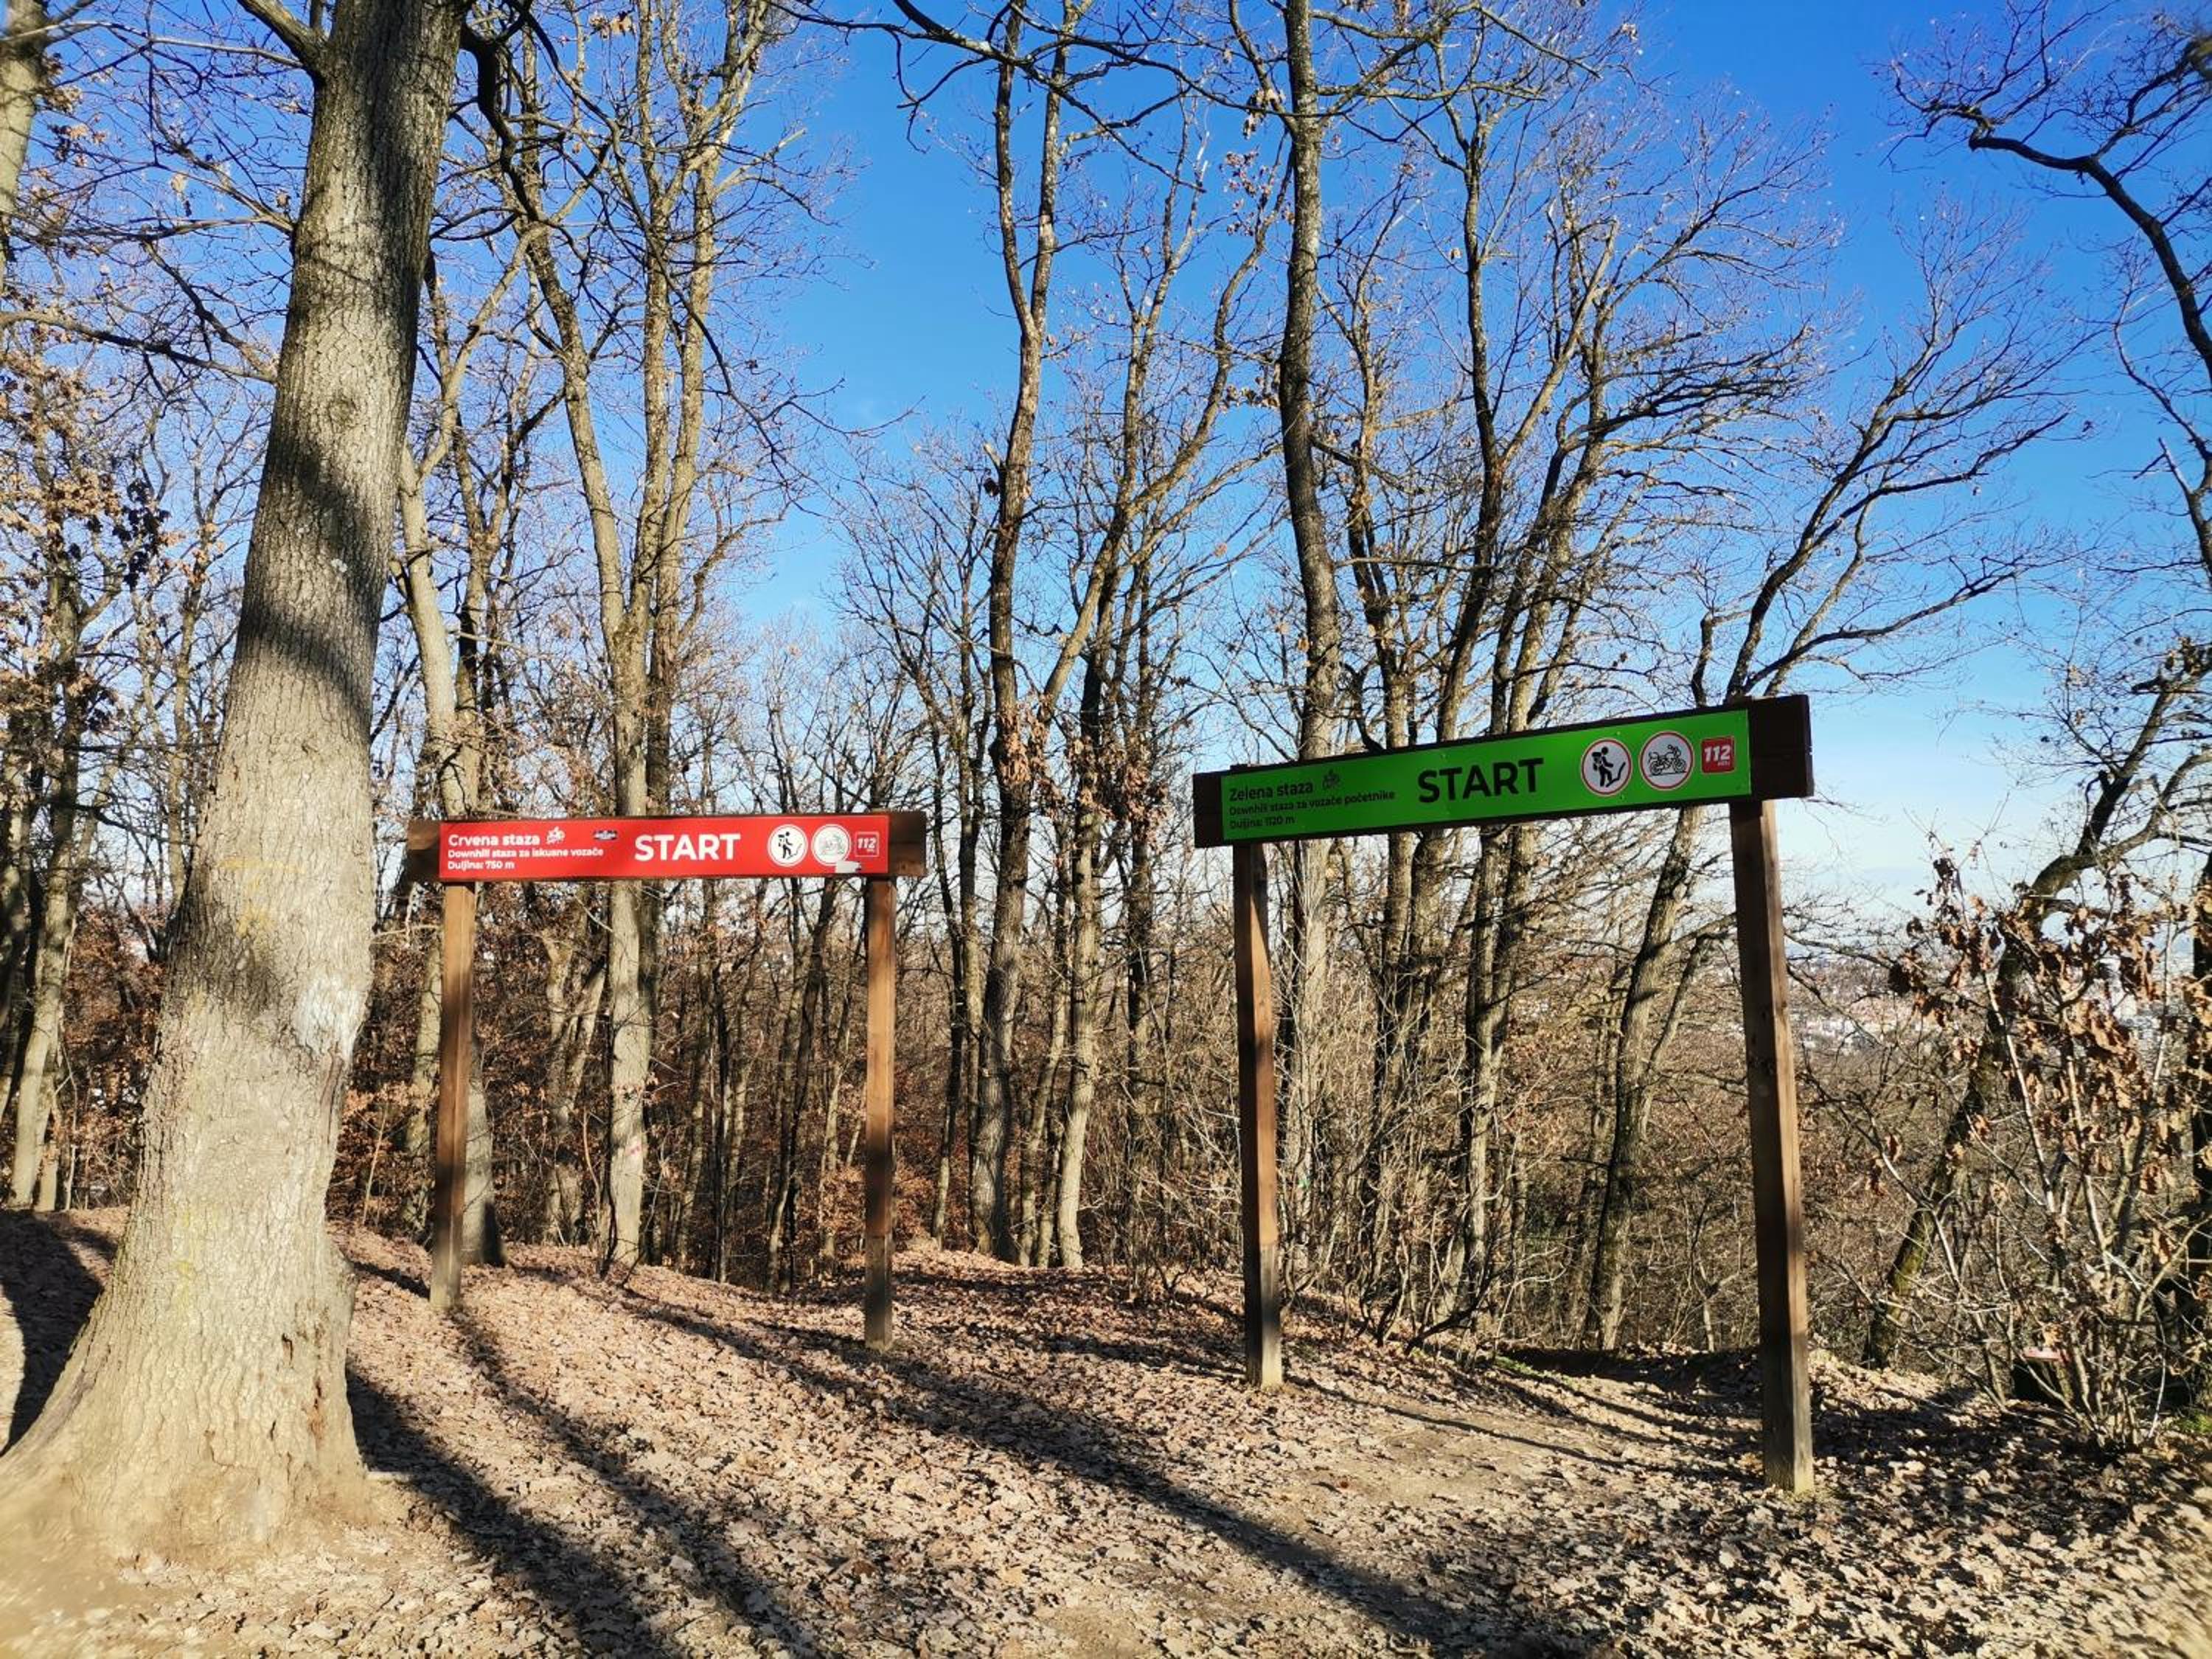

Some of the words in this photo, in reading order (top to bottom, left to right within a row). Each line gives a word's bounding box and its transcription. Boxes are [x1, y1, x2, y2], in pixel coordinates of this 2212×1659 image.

[1704, 744, 1731, 762] 112
[1417, 757, 1544, 803] START
[1229, 785, 1273, 801] Zelena
[1276, 781, 1313, 797] staza
[448, 834, 499, 846] Crvena
[502, 834, 540, 846] staza
[634, 833, 741, 861] START
[858, 837, 877, 849] 112
[448, 849, 490, 858] Downhill
[492, 849, 517, 858] staza
[532, 847, 568, 858] iskusne
[571, 846, 604, 857] vozače
[448, 860, 484, 872] Duljina:
[485, 860, 503, 870] 750
[504, 861, 515, 869] m
